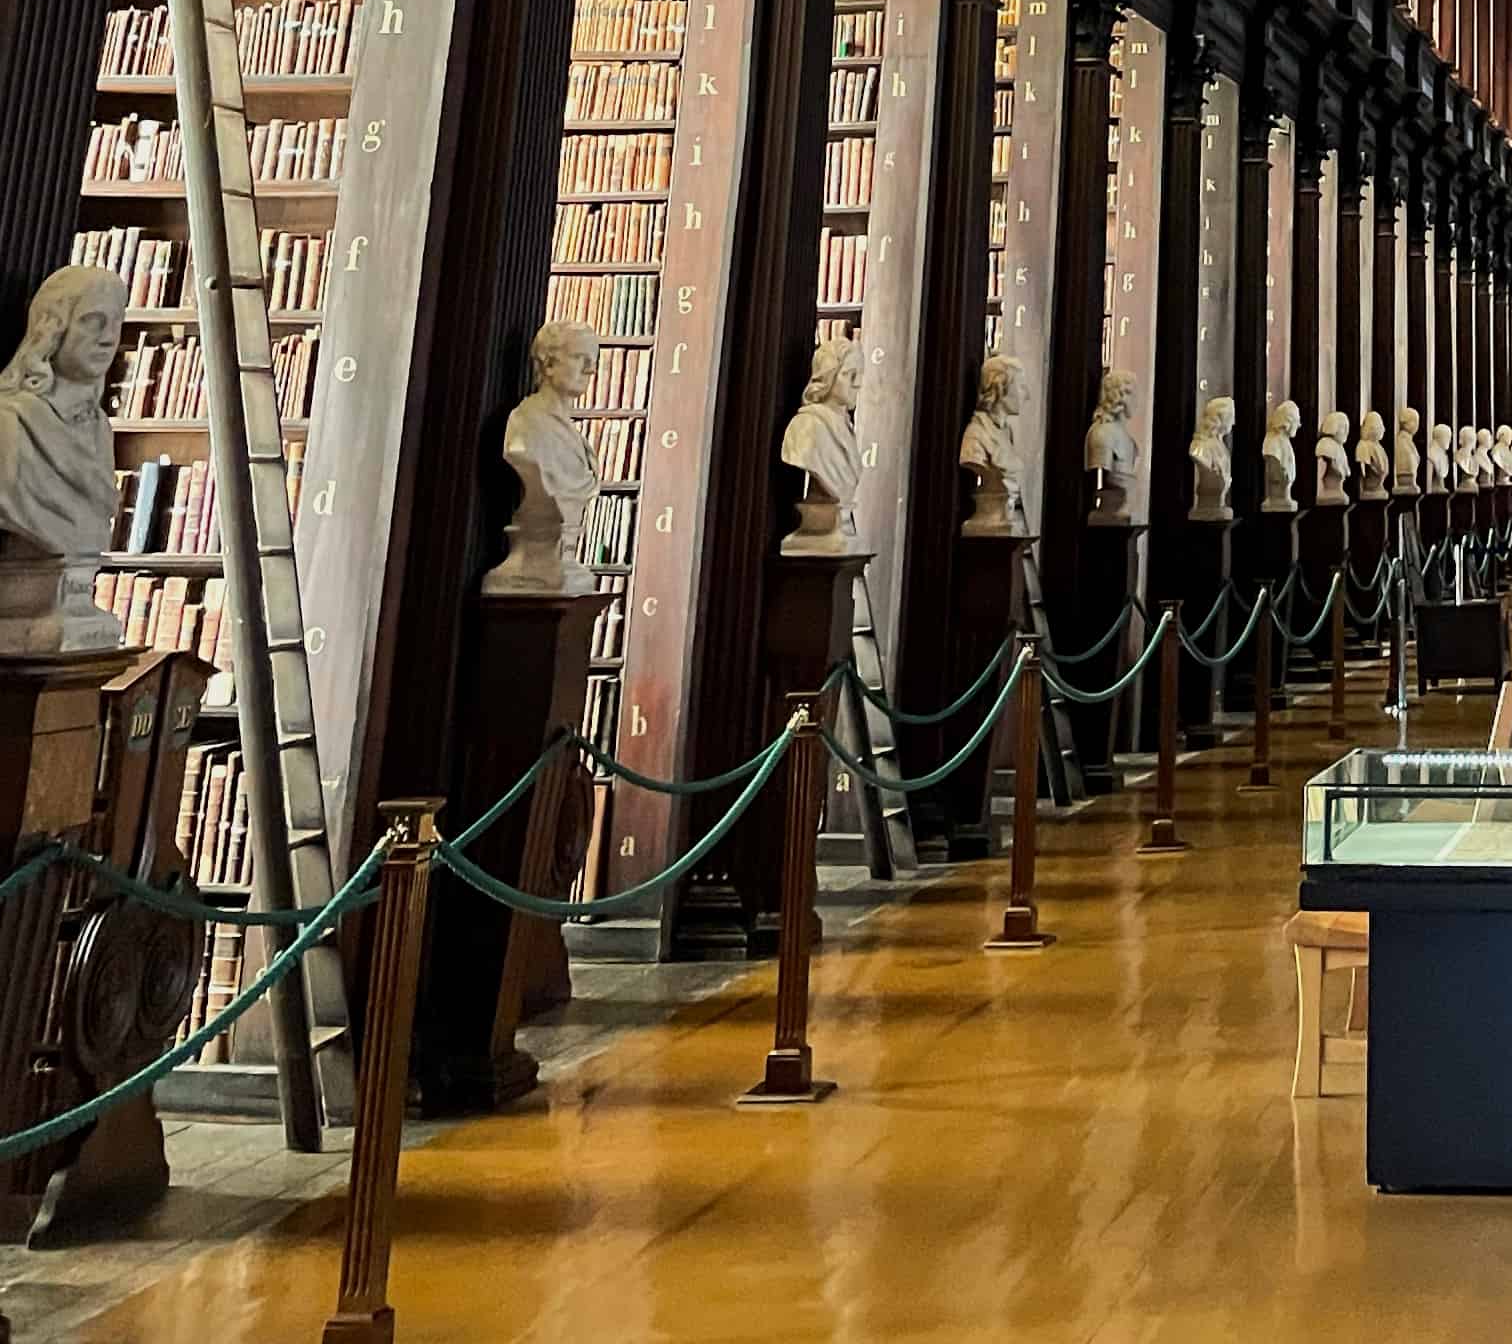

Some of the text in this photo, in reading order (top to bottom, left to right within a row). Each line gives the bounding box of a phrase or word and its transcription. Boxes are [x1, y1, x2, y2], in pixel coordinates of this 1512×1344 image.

[379, 0, 404, 34] h
[704, 4, 715, 31] l
[1029, 1, 1047, 15] m
[897, 12, 904, 35] i
[1029, 35, 1035, 56] l
[697, 73, 719, 96] k
[892, 72, 907, 96] h
[1025, 81, 1036, 102] k
[362, 120, 387, 152] g
[688, 137, 701, 166] i
[883, 151, 896, 170] g
[1022, 144, 1028, 159] i
[684, 203, 702, 230] h
[1018, 200, 1030, 222] h
[344, 236, 369, 272] f
[878, 235, 892, 262] f
[1016, 268, 1028, 285] g
[678, 286, 696, 314] g
[1015, 305, 1026, 327] f
[670, 343, 688, 374] f
[871, 347, 885, 364] e
[334, 355, 357, 382] e
[661, 431, 678, 448] e
[862, 442, 878, 468] d
[312, 480, 337, 516] d
[655, 509, 673, 533] d
[642, 597, 658, 616] c
[304, 627, 326, 656] c
[630, 705, 647, 736] b
[620, 835, 635, 857] a
